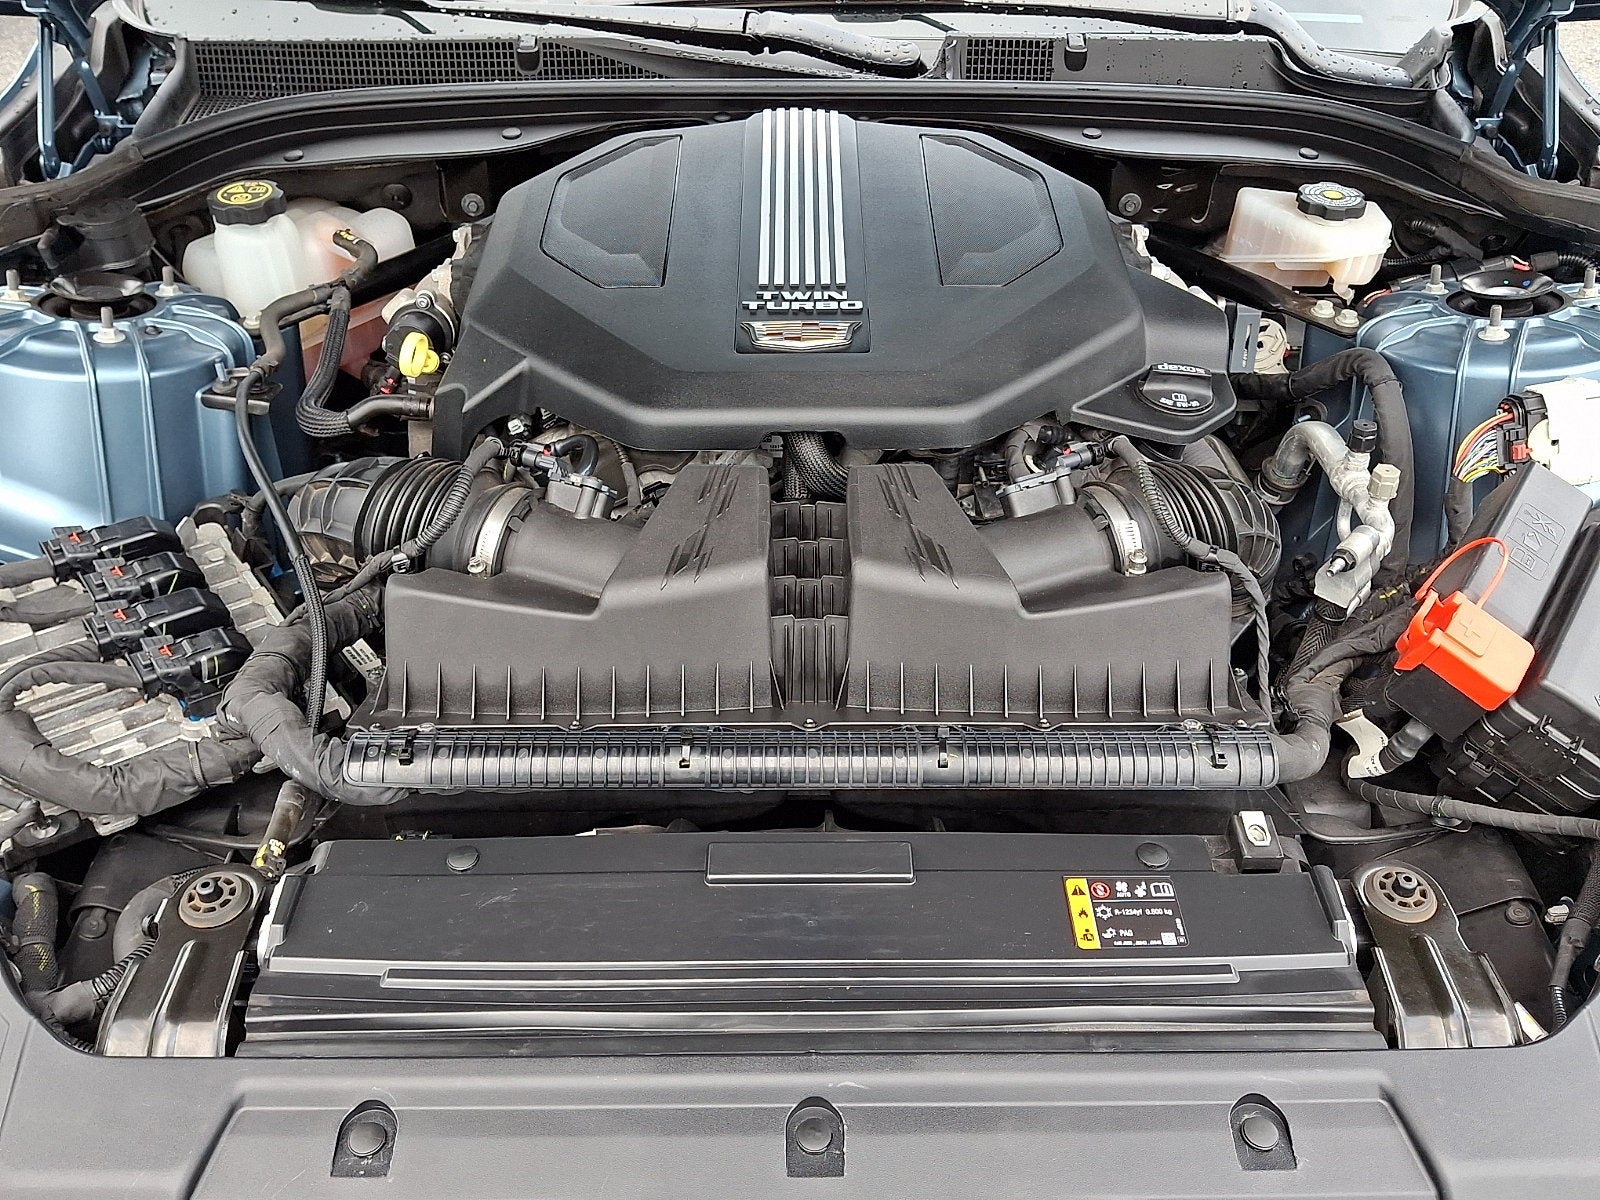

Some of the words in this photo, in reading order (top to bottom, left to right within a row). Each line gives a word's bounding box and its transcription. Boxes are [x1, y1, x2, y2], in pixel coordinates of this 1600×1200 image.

[755, 290, 848, 300] TWIN
[741, 300, 864, 311] TURBO
[1157, 362, 1206, 374] dexos
